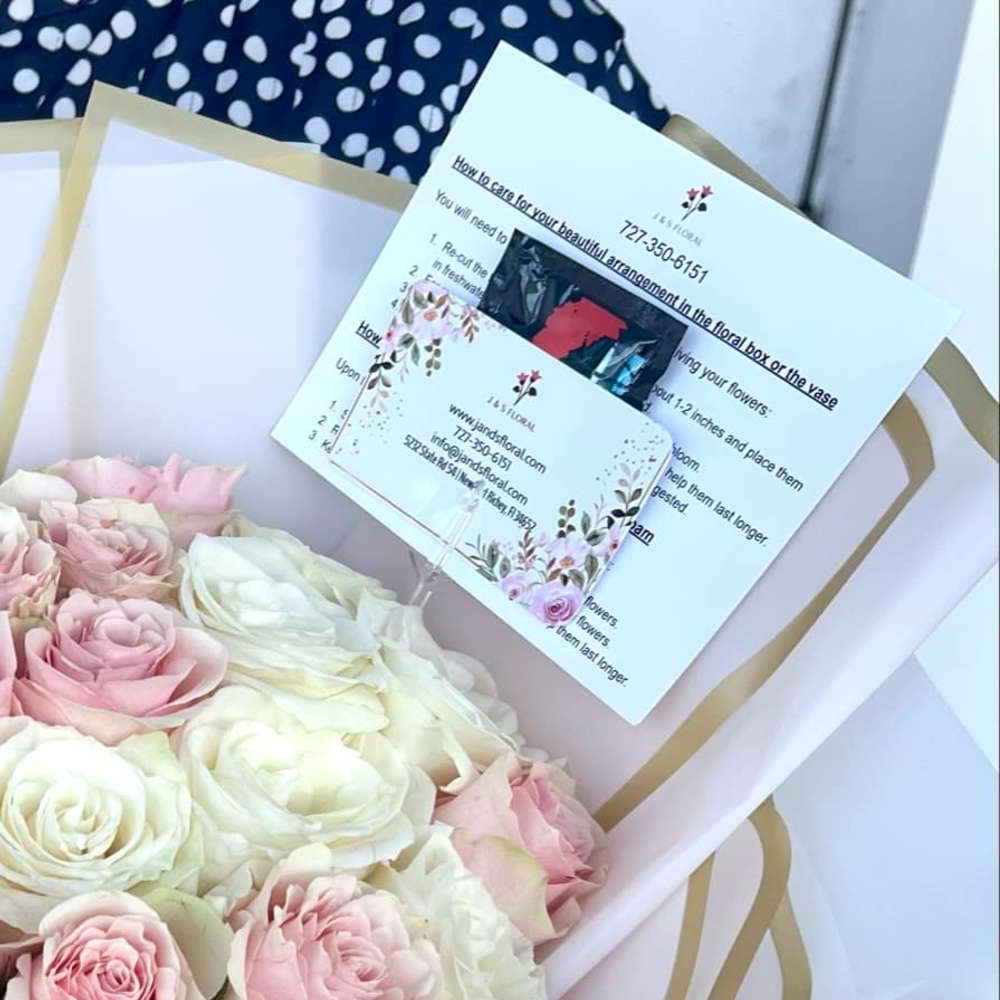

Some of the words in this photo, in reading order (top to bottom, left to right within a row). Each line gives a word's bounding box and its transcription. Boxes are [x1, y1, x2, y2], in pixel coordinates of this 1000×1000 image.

[619, 219, 709, 284] 727-350-6151
[435, 189, 454, 210] You
[453, 204, 472, 221] will
[469, 216, 498, 237] need
[496, 230, 508, 245] to
[698, 366, 729, 389] your
[726, 382, 772, 418] flowers:
[452, 155, 479, 178] How
[476, 171, 490, 187] to
[489, 181, 515, 202] care
[513, 194, 533, 212] for
[529, 207, 559, 231] your
[556, 221, 609, 261] beautiful
[604, 256, 680, 308] arrangement
[677, 298, 692, 316] in
[690, 308, 713, 330] the
[710, 320, 748, 350] floral
[743, 341, 771, 366] box
[768, 360, 787, 376] or
[783, 368, 807, 390] the
[804, 383, 838, 410] vase
[356, 320, 383, 345] How
[336, 357, 361, 382] Upon
[442, 241, 474, 269] Re-cut
[472, 262, 488, 279] the
[674, 398, 693, 416] 1-2
[689, 409, 725, 439] inches
[724, 434, 749, 453] and
[743, 448, 776, 473] place
[775, 467, 804, 492] them
[449, 404, 546, 474] www.jandsfloral.com
[453, 425, 512, 472] 727-350-6151
[506, 408, 536, 433] FLORAL
[430, 432, 528, 506] info@jandsfloral.com
[661, 466, 688, 489] help
[687, 483, 714, 508] them
[713, 501, 735, 522] last
[555, 625, 581, 648] them
[579, 642, 599, 663] last
